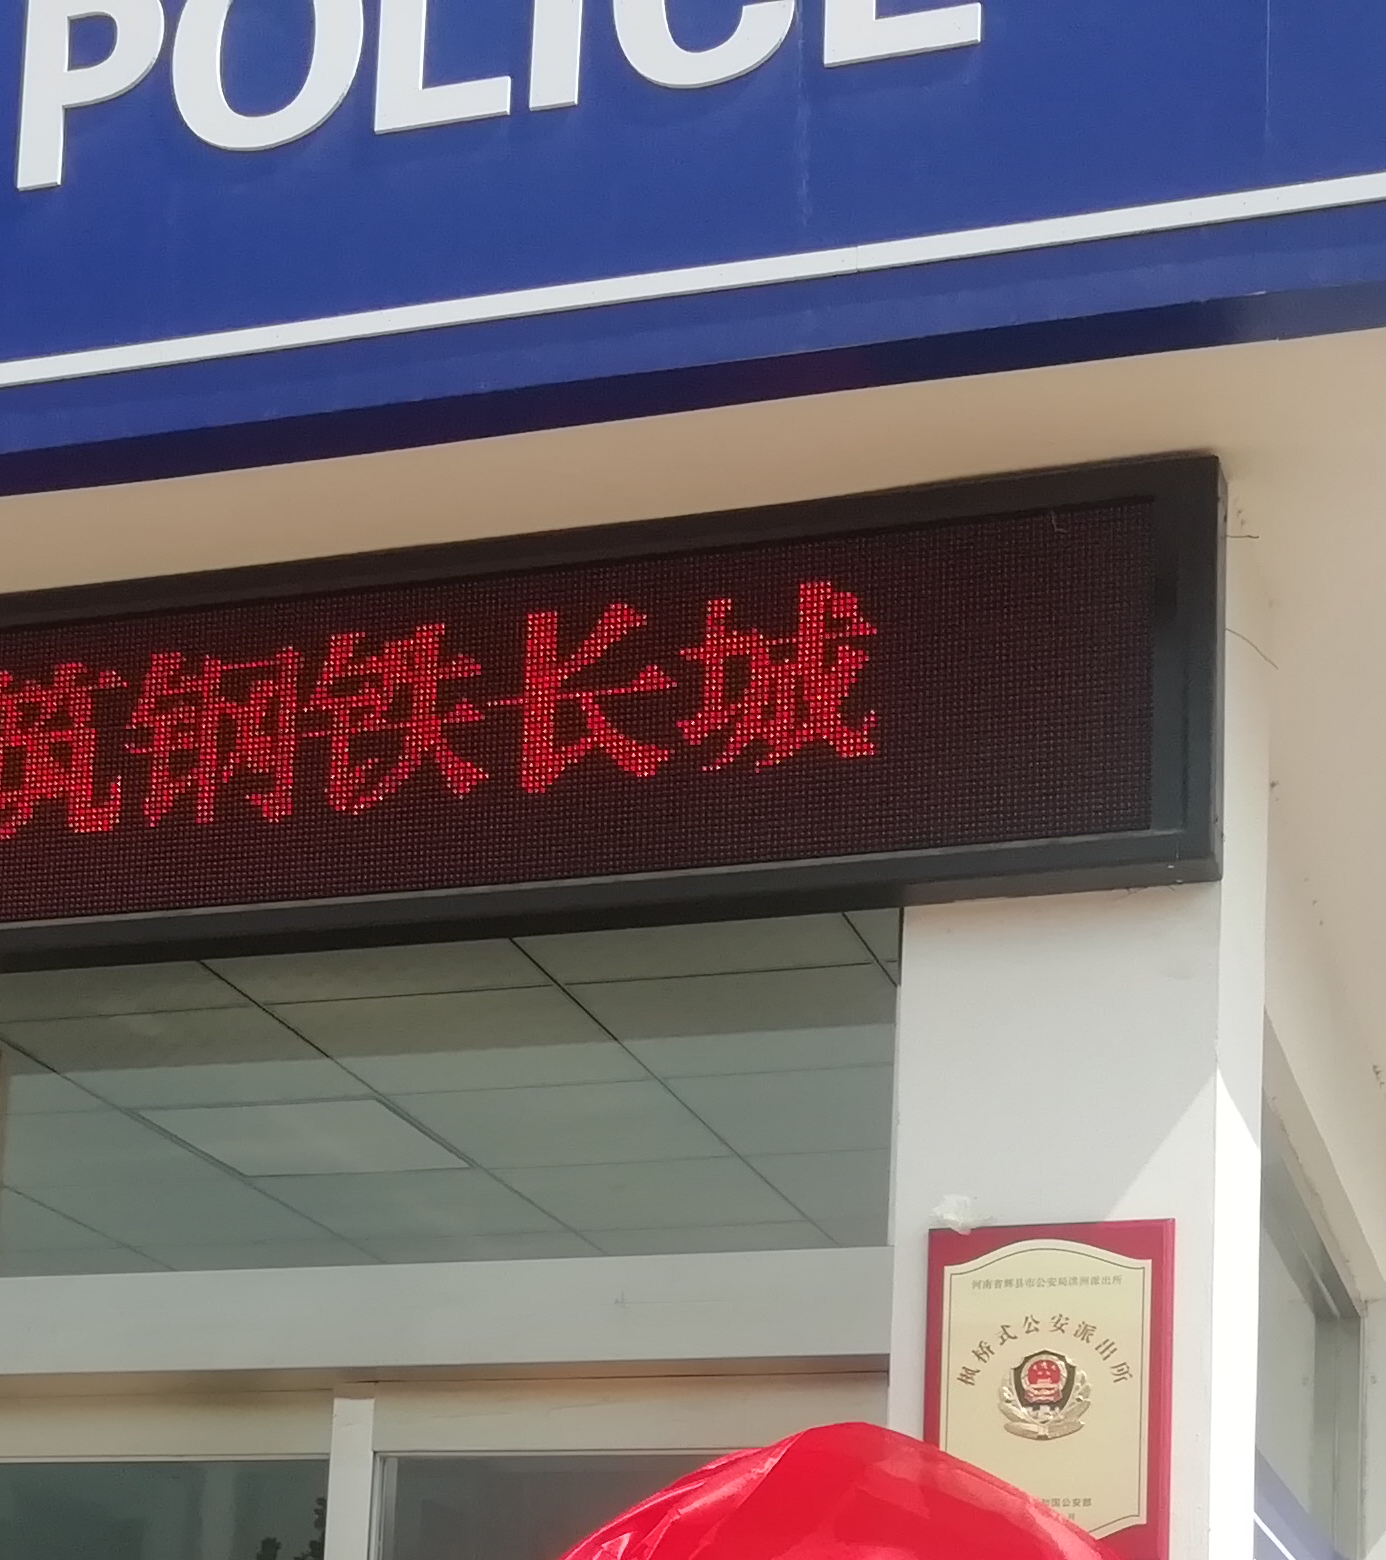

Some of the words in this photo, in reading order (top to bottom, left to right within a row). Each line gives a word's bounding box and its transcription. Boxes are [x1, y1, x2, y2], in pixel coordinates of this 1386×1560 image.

[956, 1312, 1134, 1387] 枫桥式公安派出所
